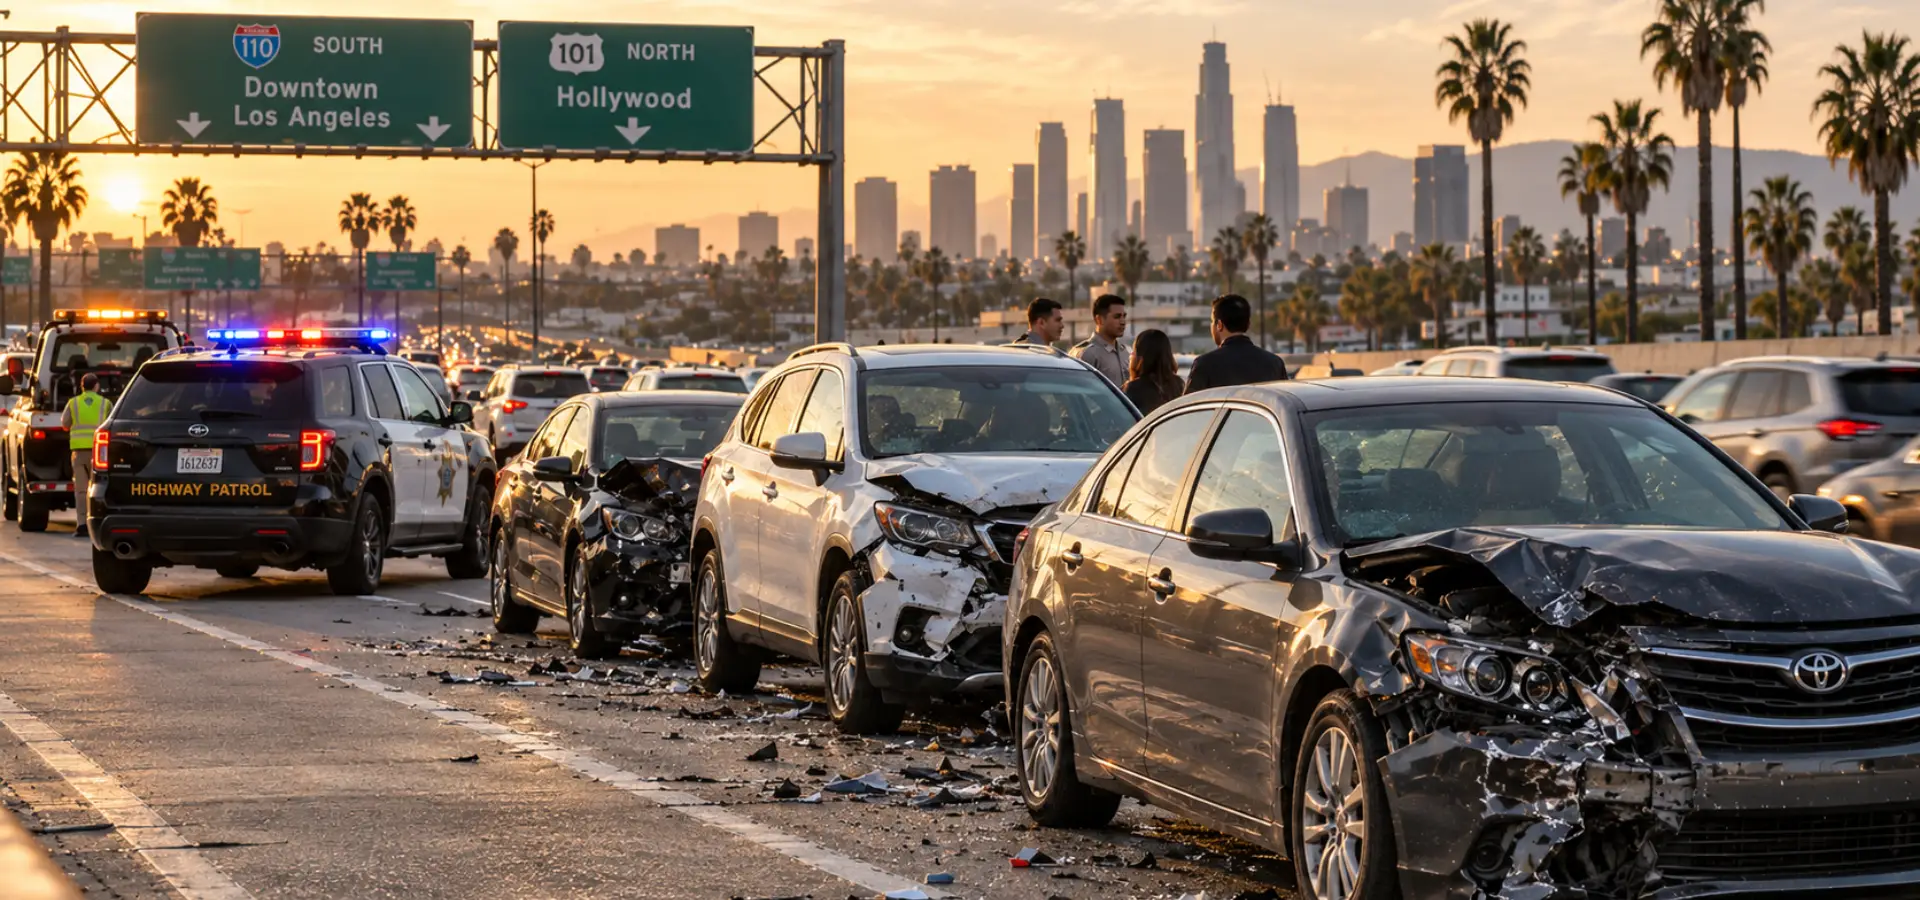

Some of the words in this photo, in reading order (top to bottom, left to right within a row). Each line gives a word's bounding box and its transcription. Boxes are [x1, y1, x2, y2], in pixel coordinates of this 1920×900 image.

[241, 37, 273, 58] 110
[313, 36, 383, 55] SOUTH
[558, 43, 595, 65] 101
[627, 42, 695, 61] NORTH
[245, 75, 378, 99] Downtown
[557, 85, 691, 113] Hollywood
[234, 104, 278, 126] Los
[288, 105, 391, 132] Angeles
[131, 483, 203, 496] HIGHWAY
[210, 483, 272, 496] PATROL
